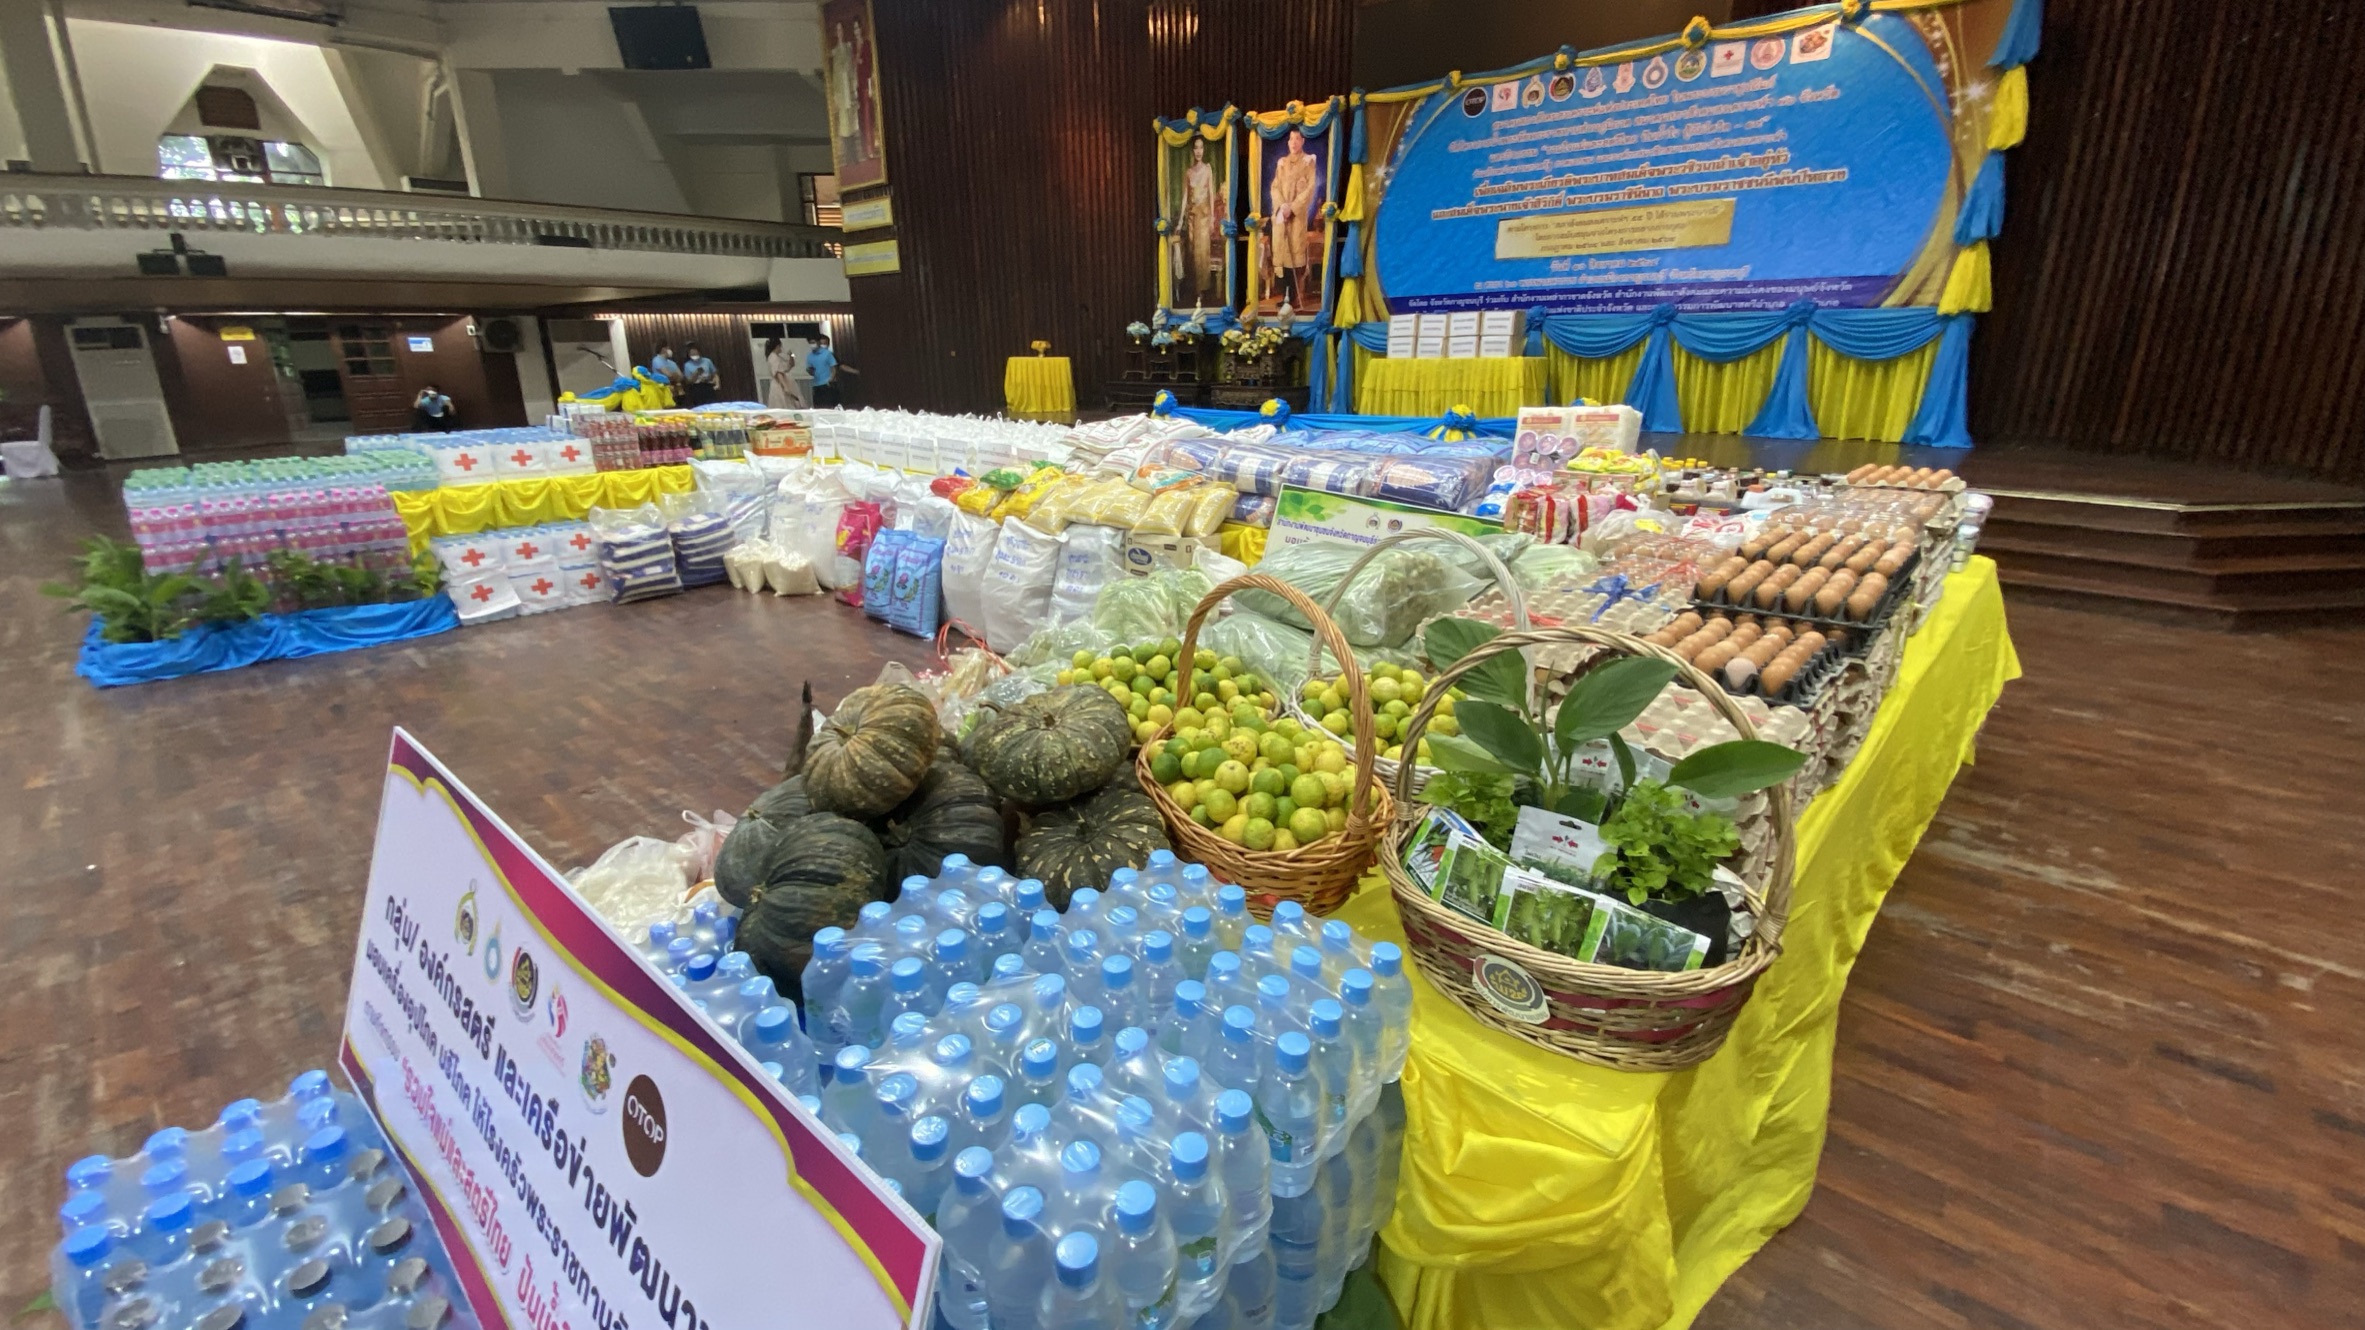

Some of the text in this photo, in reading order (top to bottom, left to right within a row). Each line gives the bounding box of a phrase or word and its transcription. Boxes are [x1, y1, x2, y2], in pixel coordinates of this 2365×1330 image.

[418, 936, 498, 1062] องค์กรสตรี
[494, 1045, 708, 1330] และเครือข่ายพัฒนา
[626, 1092, 666, 1146] OTOP
